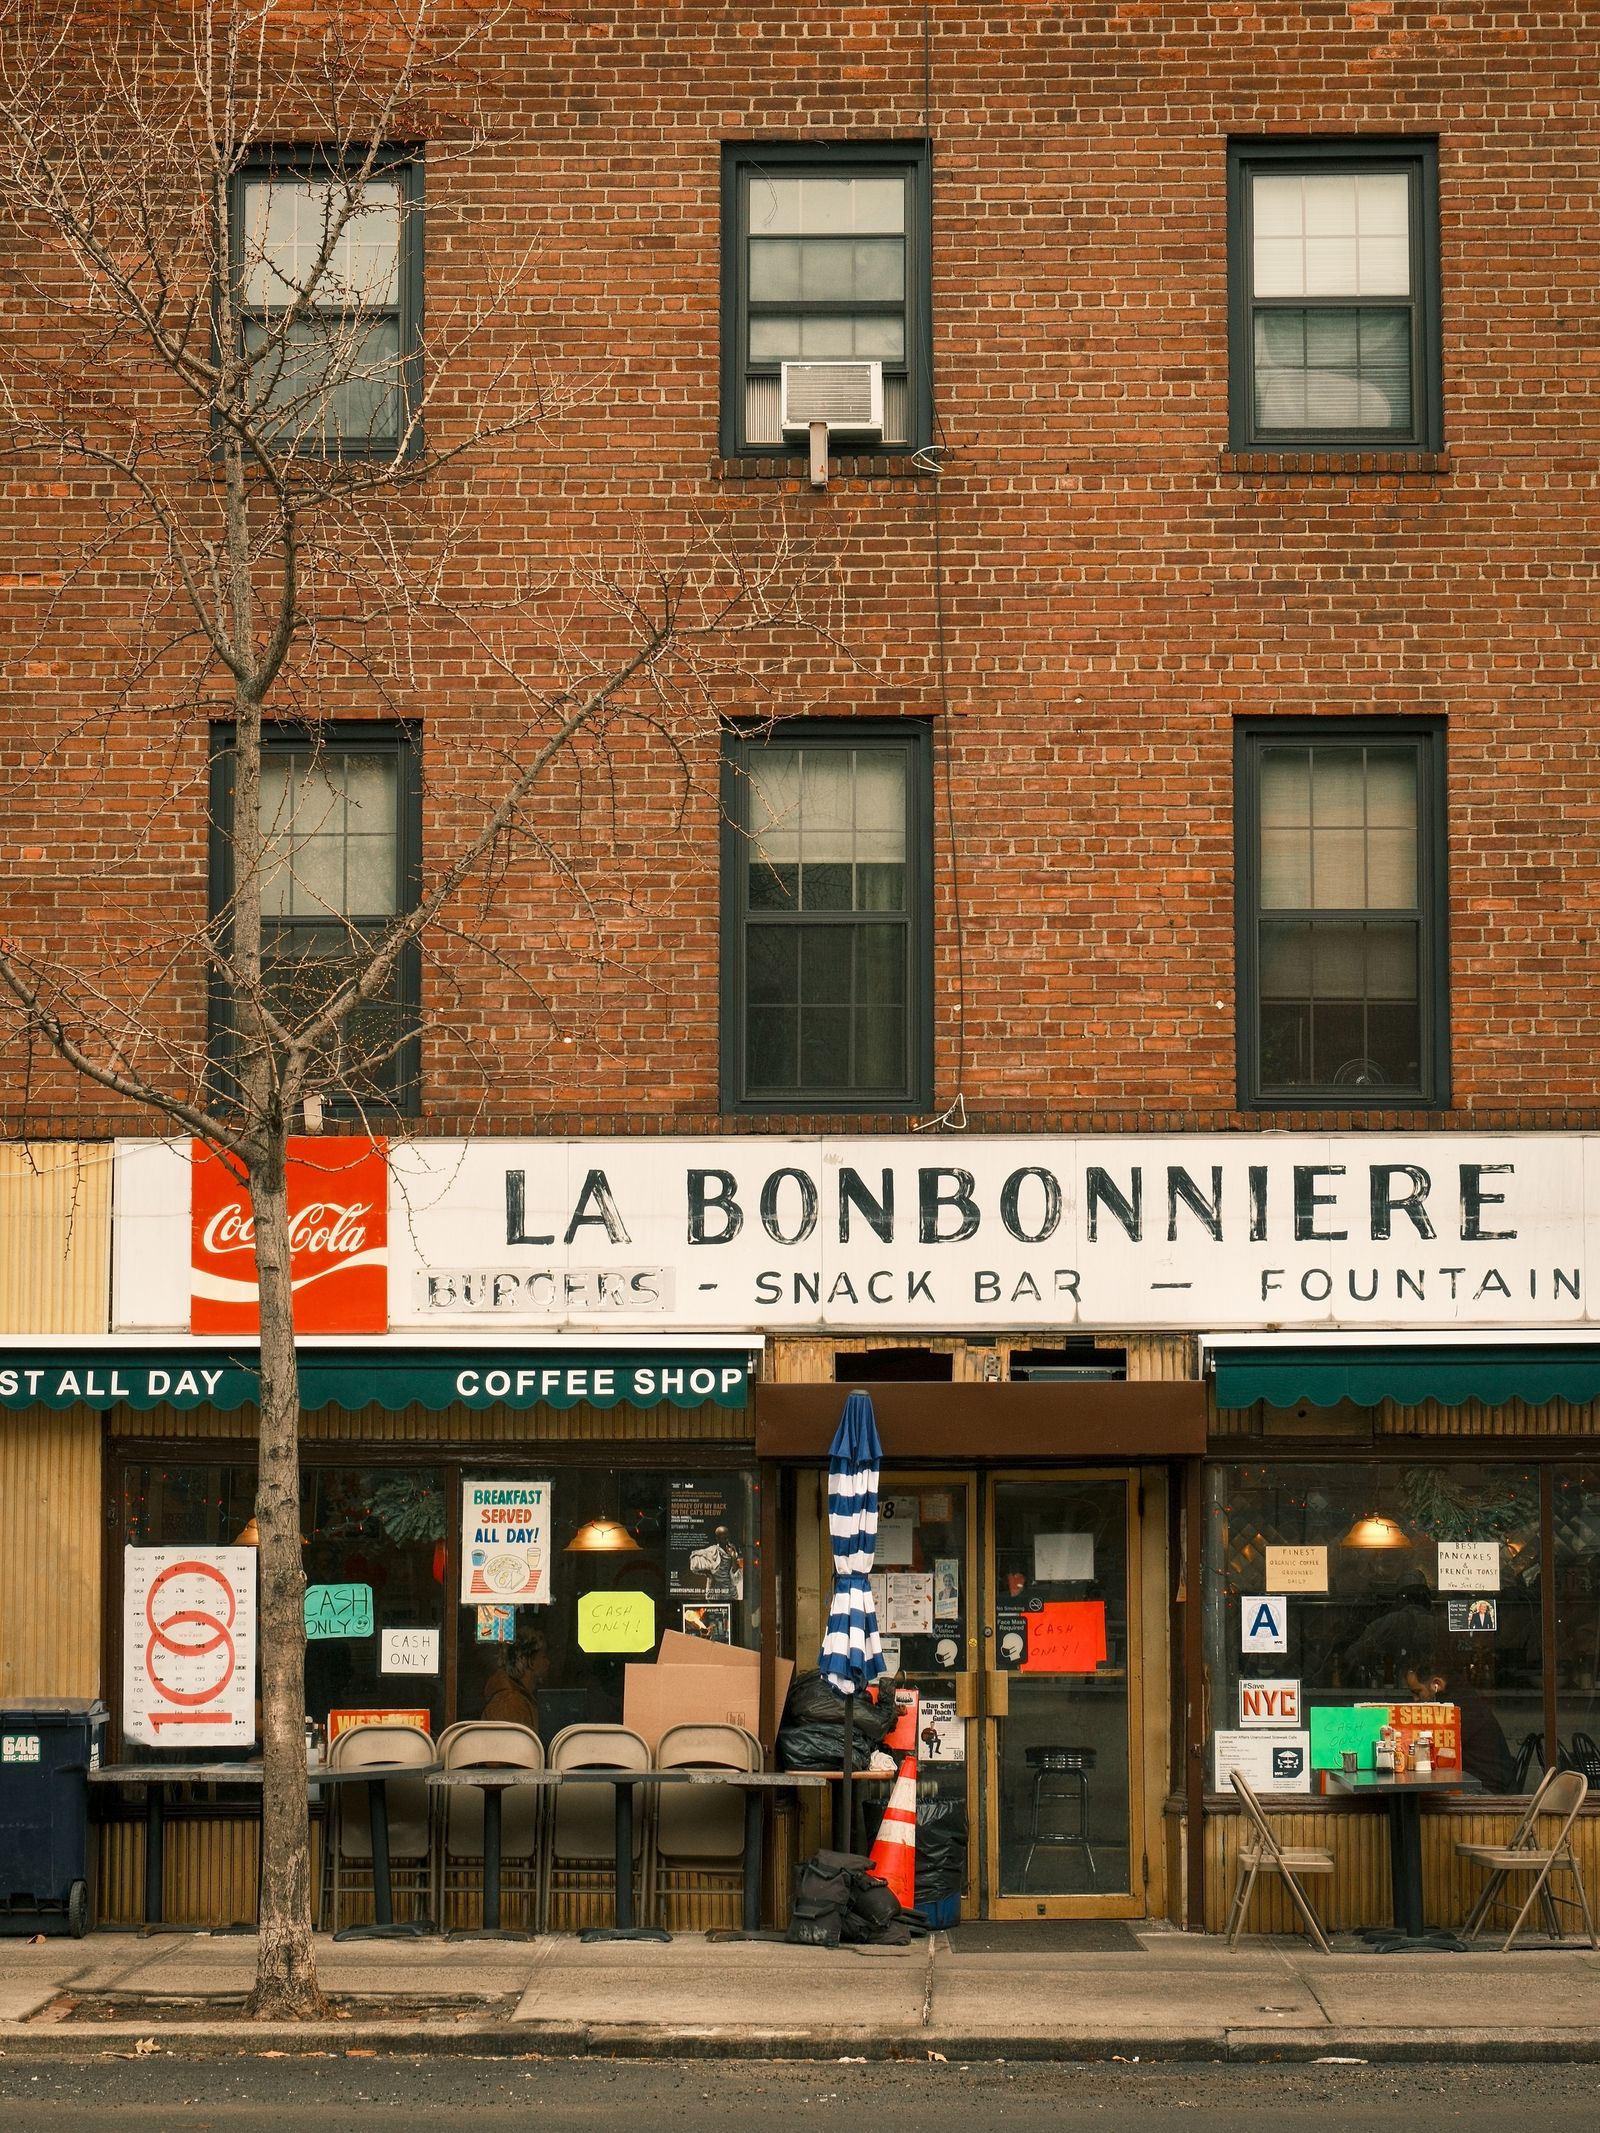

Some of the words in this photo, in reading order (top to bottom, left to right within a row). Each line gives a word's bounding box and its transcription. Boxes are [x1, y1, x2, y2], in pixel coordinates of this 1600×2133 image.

[506, 1169, 632, 1245] LA
[687, 1163, 1518, 1245] BONBONNIERE
[203, 1202, 373, 1253] CocCola
[428, 1272, 660, 1307] BURGERS
[754, 1271, 935, 1304] SNACK
[974, 1269, 1081, 1303] BAR
[1261, 1268, 1581, 1301] FOUNTAIN
[0, 1370, 45, 1396] ST
[56, 1370, 130, 1396] ALL
[148, 1370, 224, 1395] DAY
[455, 1369, 615, 1396] COFFEE
[633, 1368, 742, 1395] SHOP
[473, 1489, 543, 1505] BREAKFAST
[481, 1508, 532, 1524] SERVED
[474, 1528, 499, 1543] ALL
[506, 1527, 540, 1543] DAY!
[1455, 1542, 1478, 1550] BEST
[1440, 1552, 1492, 1560] PANCAKES
[304, 1588, 368, 1616] CASH
[591, 1604, 633, 1618] CASH
[304, 1619, 351, 1635] ONLY
[1250, 1603, 1279, 1637] A
[1034, 1624, 1074, 1636] CASH
[391, 1635, 430, 1648] CASH
[390, 1653, 429, 1666] ONLY
[1243, 1682, 1265, 1690] #Save
[1243, 1690, 1296, 1717] NYC
[1400, 1706, 1456, 1724] SERVE
[1324, 1720, 1365, 1732] CASH
[2, 1736, 40, 1755] 64G
[1330, 1736, 1364, 1747] ONLY
